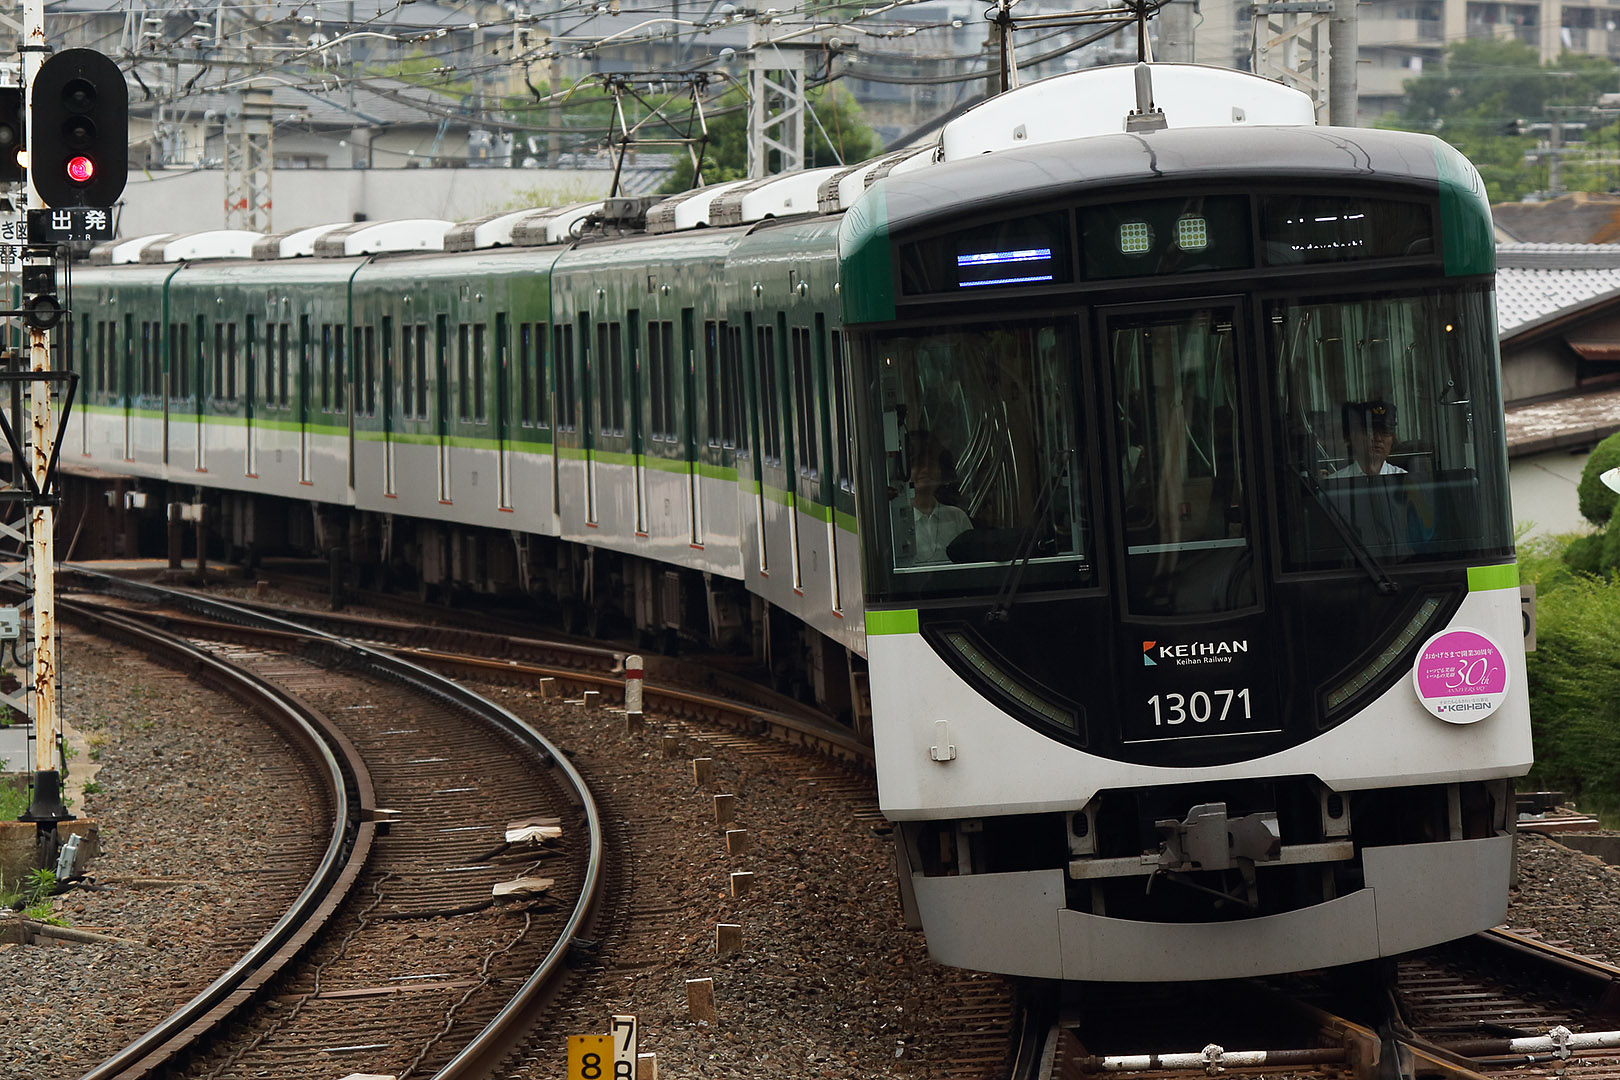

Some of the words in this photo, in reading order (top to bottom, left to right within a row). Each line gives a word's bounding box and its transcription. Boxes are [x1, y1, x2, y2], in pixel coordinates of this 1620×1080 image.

[52, 210, 106, 230] 出発
[1159, 640, 1248, 658] KEIHAN
[1176, 658, 1202, 666] Keihan
[1203, 656, 1233, 665] Railway
[1147, 688, 1252, 726] 13071
[581, 1053, 602, 1079] 8
